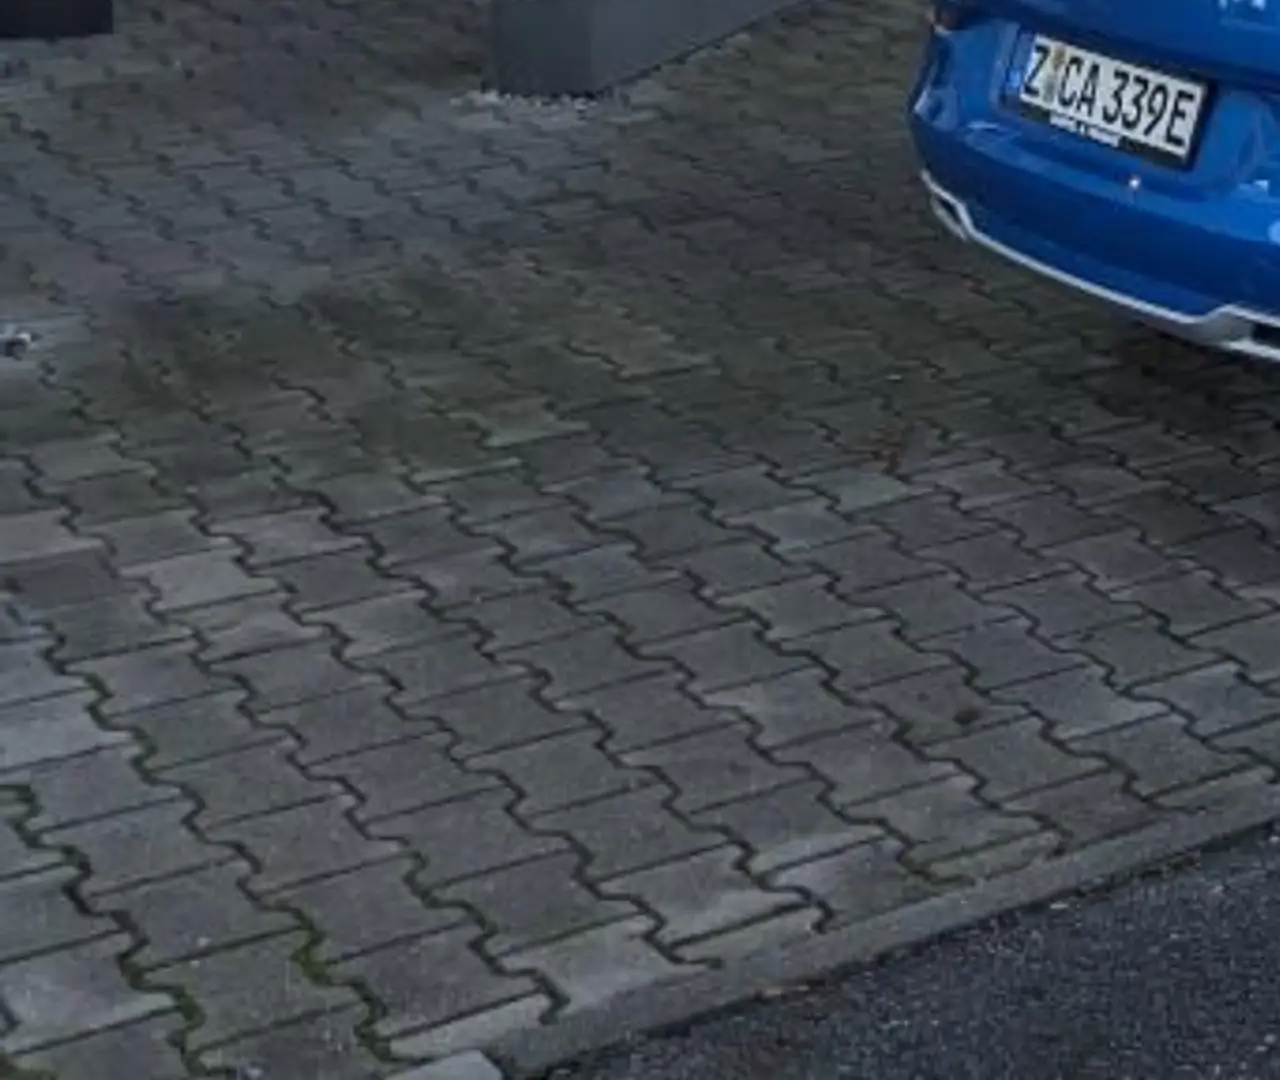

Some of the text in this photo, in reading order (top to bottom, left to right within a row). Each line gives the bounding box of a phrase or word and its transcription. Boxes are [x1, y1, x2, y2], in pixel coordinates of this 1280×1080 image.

[1024, 44, 1050, 97] Z
[1058, 56, 1100, 118] CA
[1102, 68, 1195, 147] 339E
